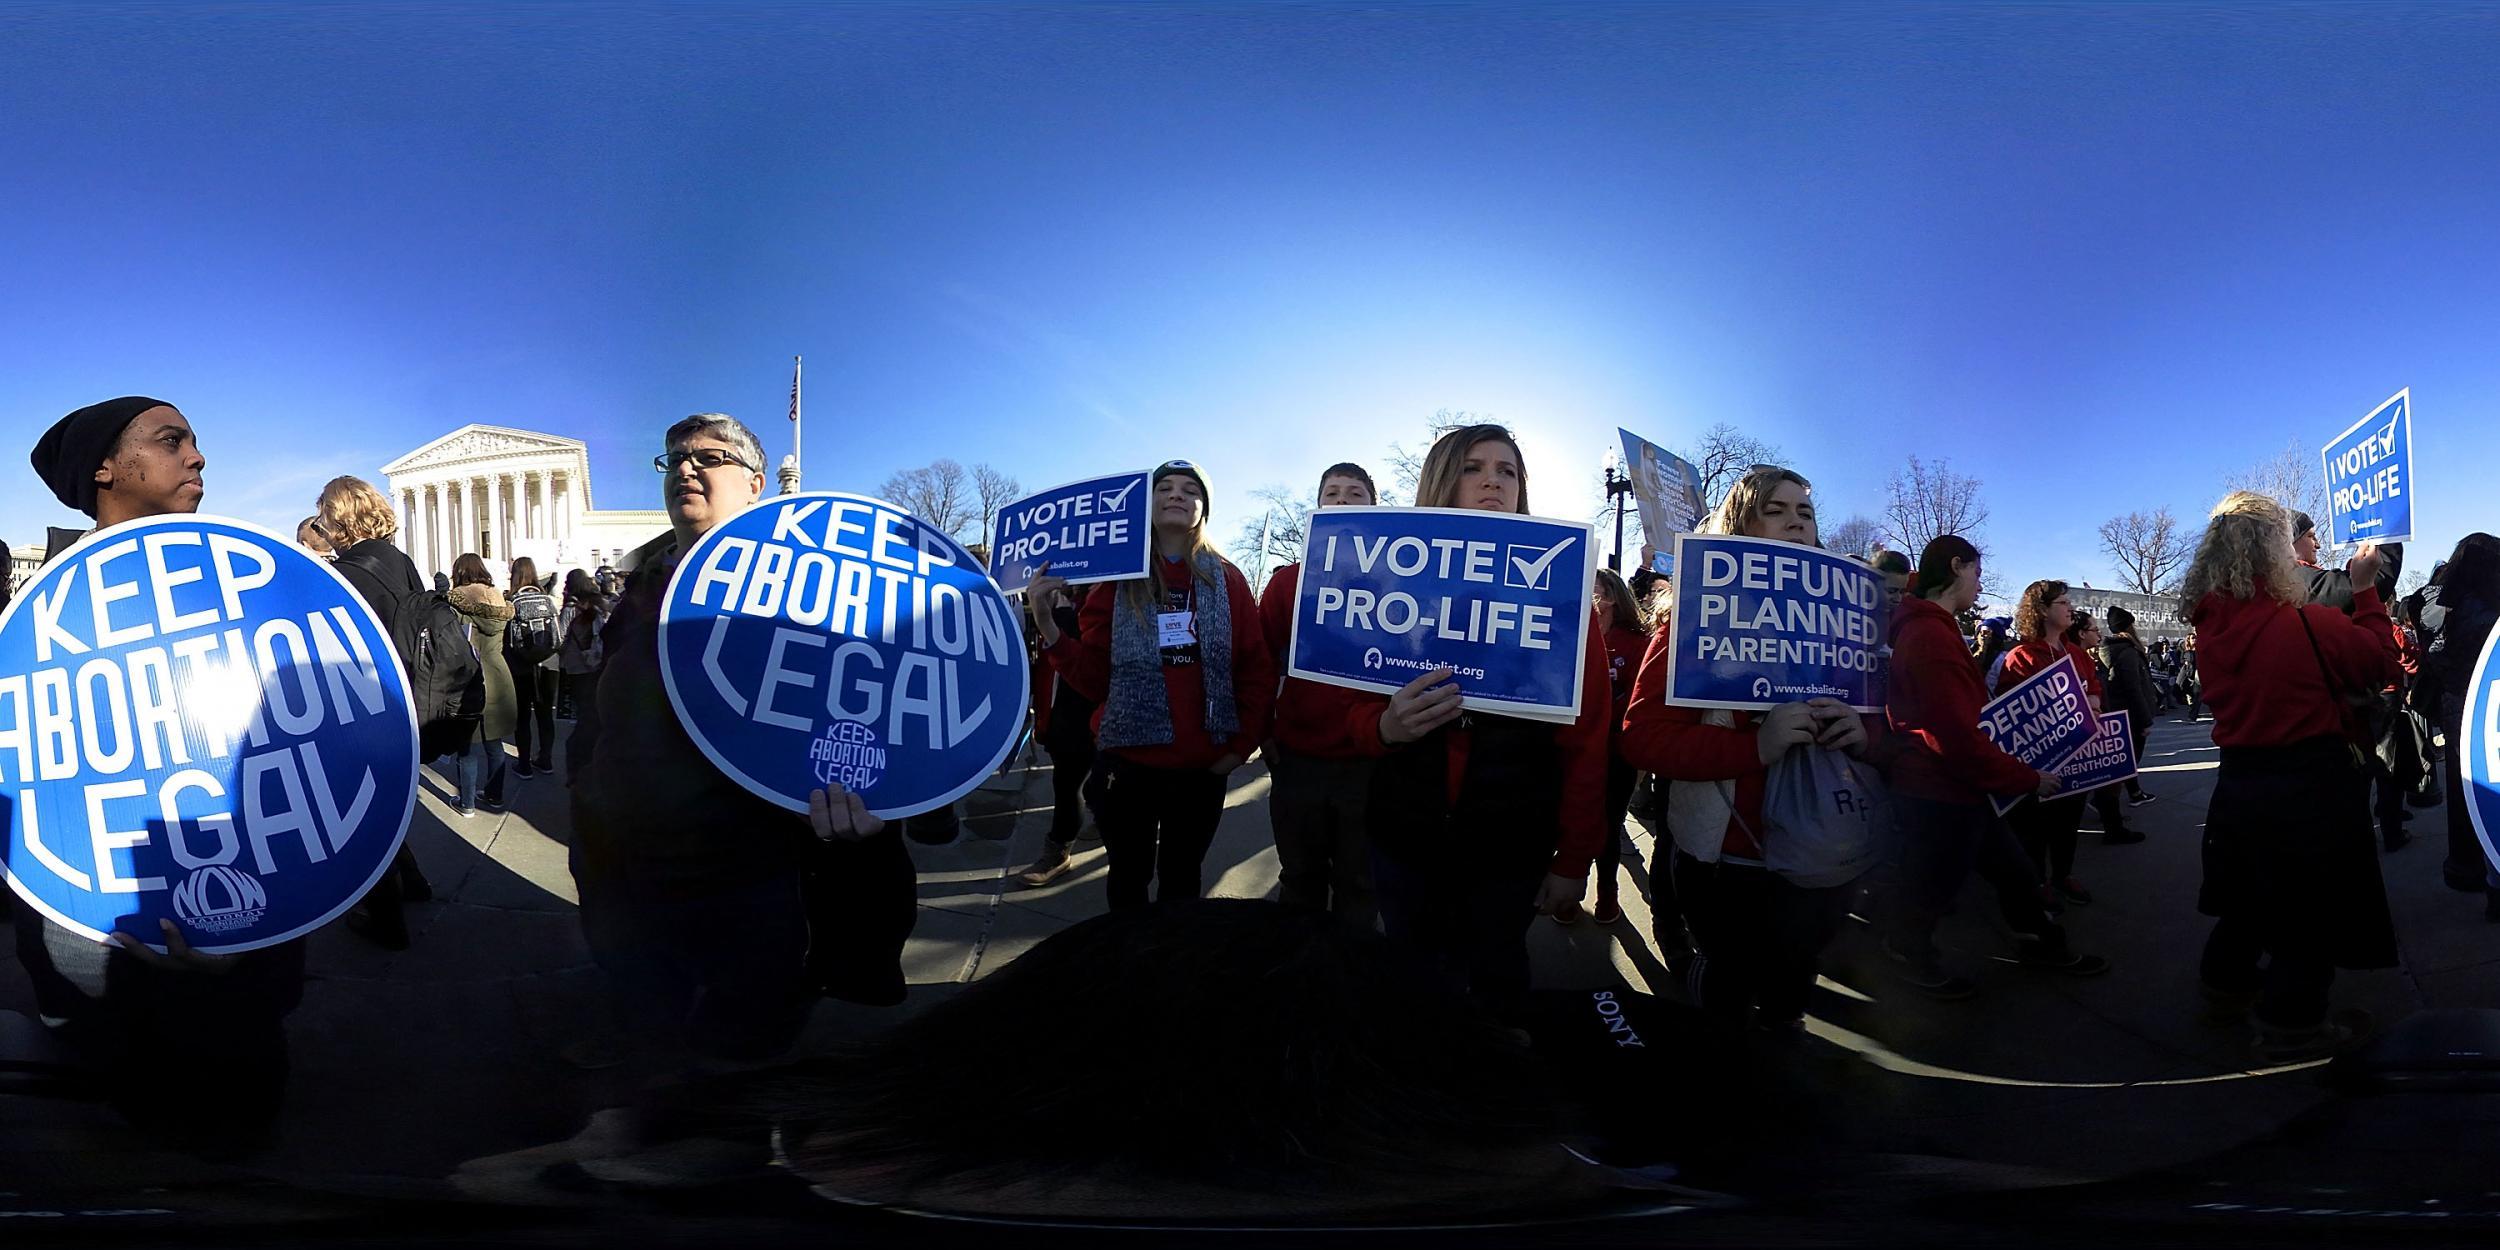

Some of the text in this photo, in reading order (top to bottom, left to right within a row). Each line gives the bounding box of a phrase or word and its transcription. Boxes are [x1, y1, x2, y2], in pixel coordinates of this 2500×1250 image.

[2330, 434, 2378, 485] I VOTE
[1003, 493, 1093, 538] I VOTE
[2334, 465, 2400, 516] PRO-LIFE
[771, 498, 957, 577] KEEP
[999, 518, 1129, 566] PRO-LIFE
[1323, 535, 1496, 583] I VOTE
[33, 531, 276, 663] KEEP
[690, 536, 1009, 666] ABORTION
[1702, 550, 1879, 611] DEFUND
[1315, 586, 1553, 650] PRO-LIFE
[1699, 594, 1879, 646] PLANNED
[1697, 635, 1879, 673] PARENTHOOD
[701, 615, 992, 750] LEGAL
[1773, 683, 1849, 699] www.sbalist.org
[827, 721, 875, 745] KEEP
[1998, 692, 2078, 756] LANNED
[810, 739, 886, 770] ABORTION
[813, 760, 878, 790] LEGAL
[2055, 752, 2127, 779] ARENTHOOD
[20, 742, 377, 895] LEGAL
[172, 866, 267, 919] NOW
[186, 910, 264, 926] NATIONAL
[1592, 991, 1646, 1048] SONY
